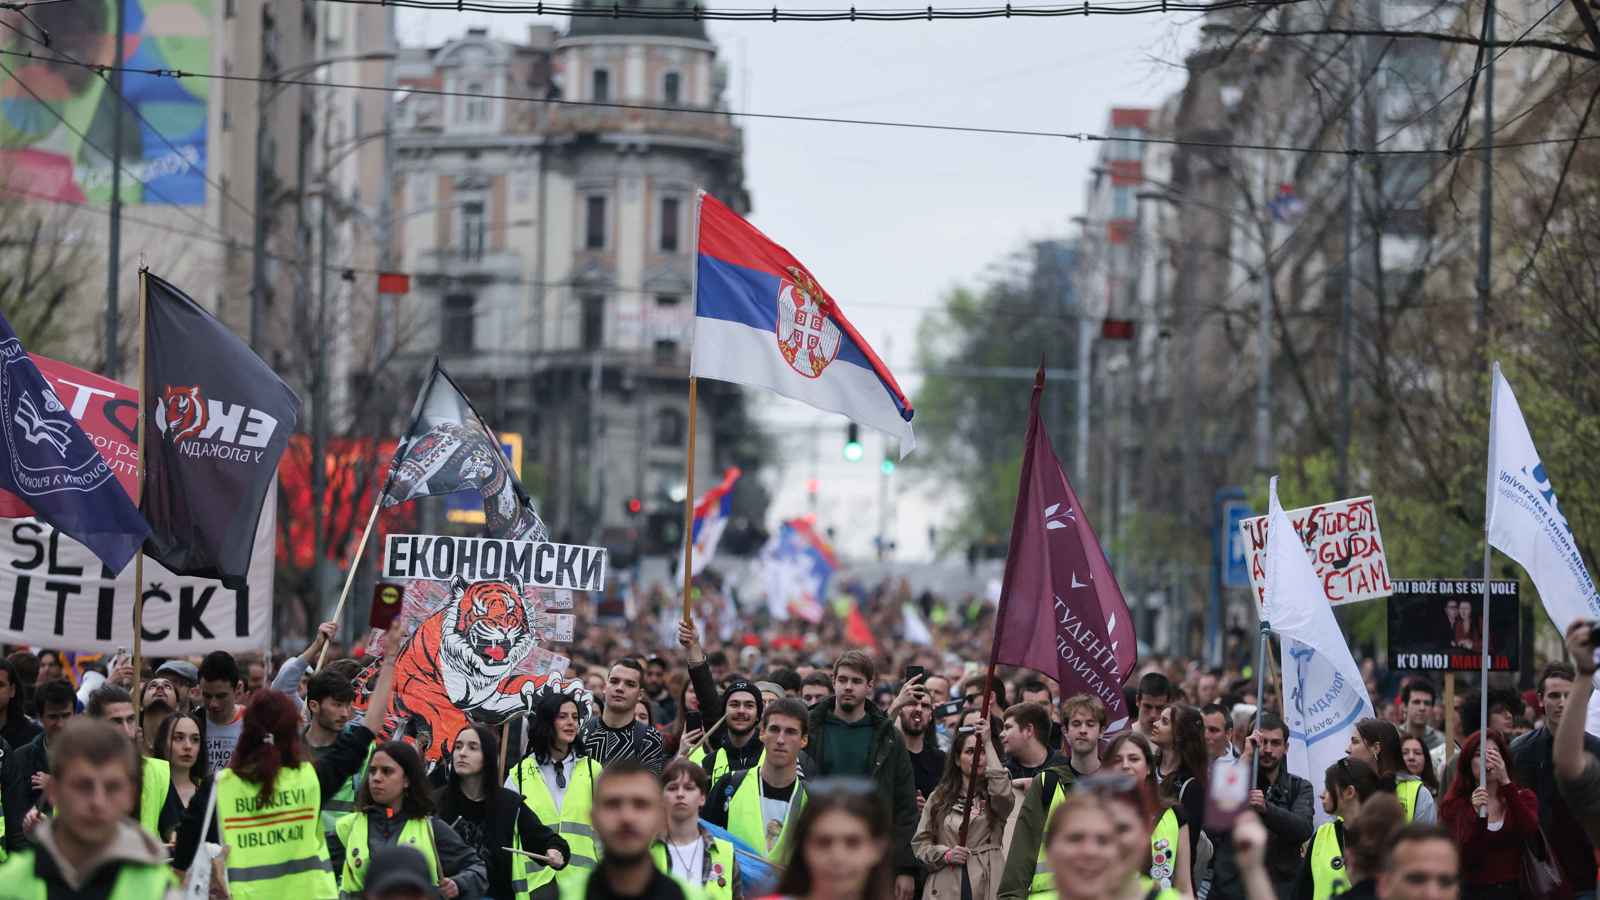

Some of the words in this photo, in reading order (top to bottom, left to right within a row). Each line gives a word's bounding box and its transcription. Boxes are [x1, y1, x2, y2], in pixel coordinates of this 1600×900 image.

[388, 536, 605, 591] ЕКОНОМСКИ
[1548, 517, 1571, 551] Union
[1570, 551, 1593, 589] Nikola
[1316, 559, 1392, 602] ETAM
[1391, 582, 1409, 593] DAJ
[1411, 579, 1437, 593] BOŽE
[1440, 582, 1453, 593] DA
[1456, 582, 1468, 593] SE
[1471, 582, 1487, 594] SV
[1491, 583, 1515, 594] VOLE
[1421, 654, 1448, 669] MOJ
